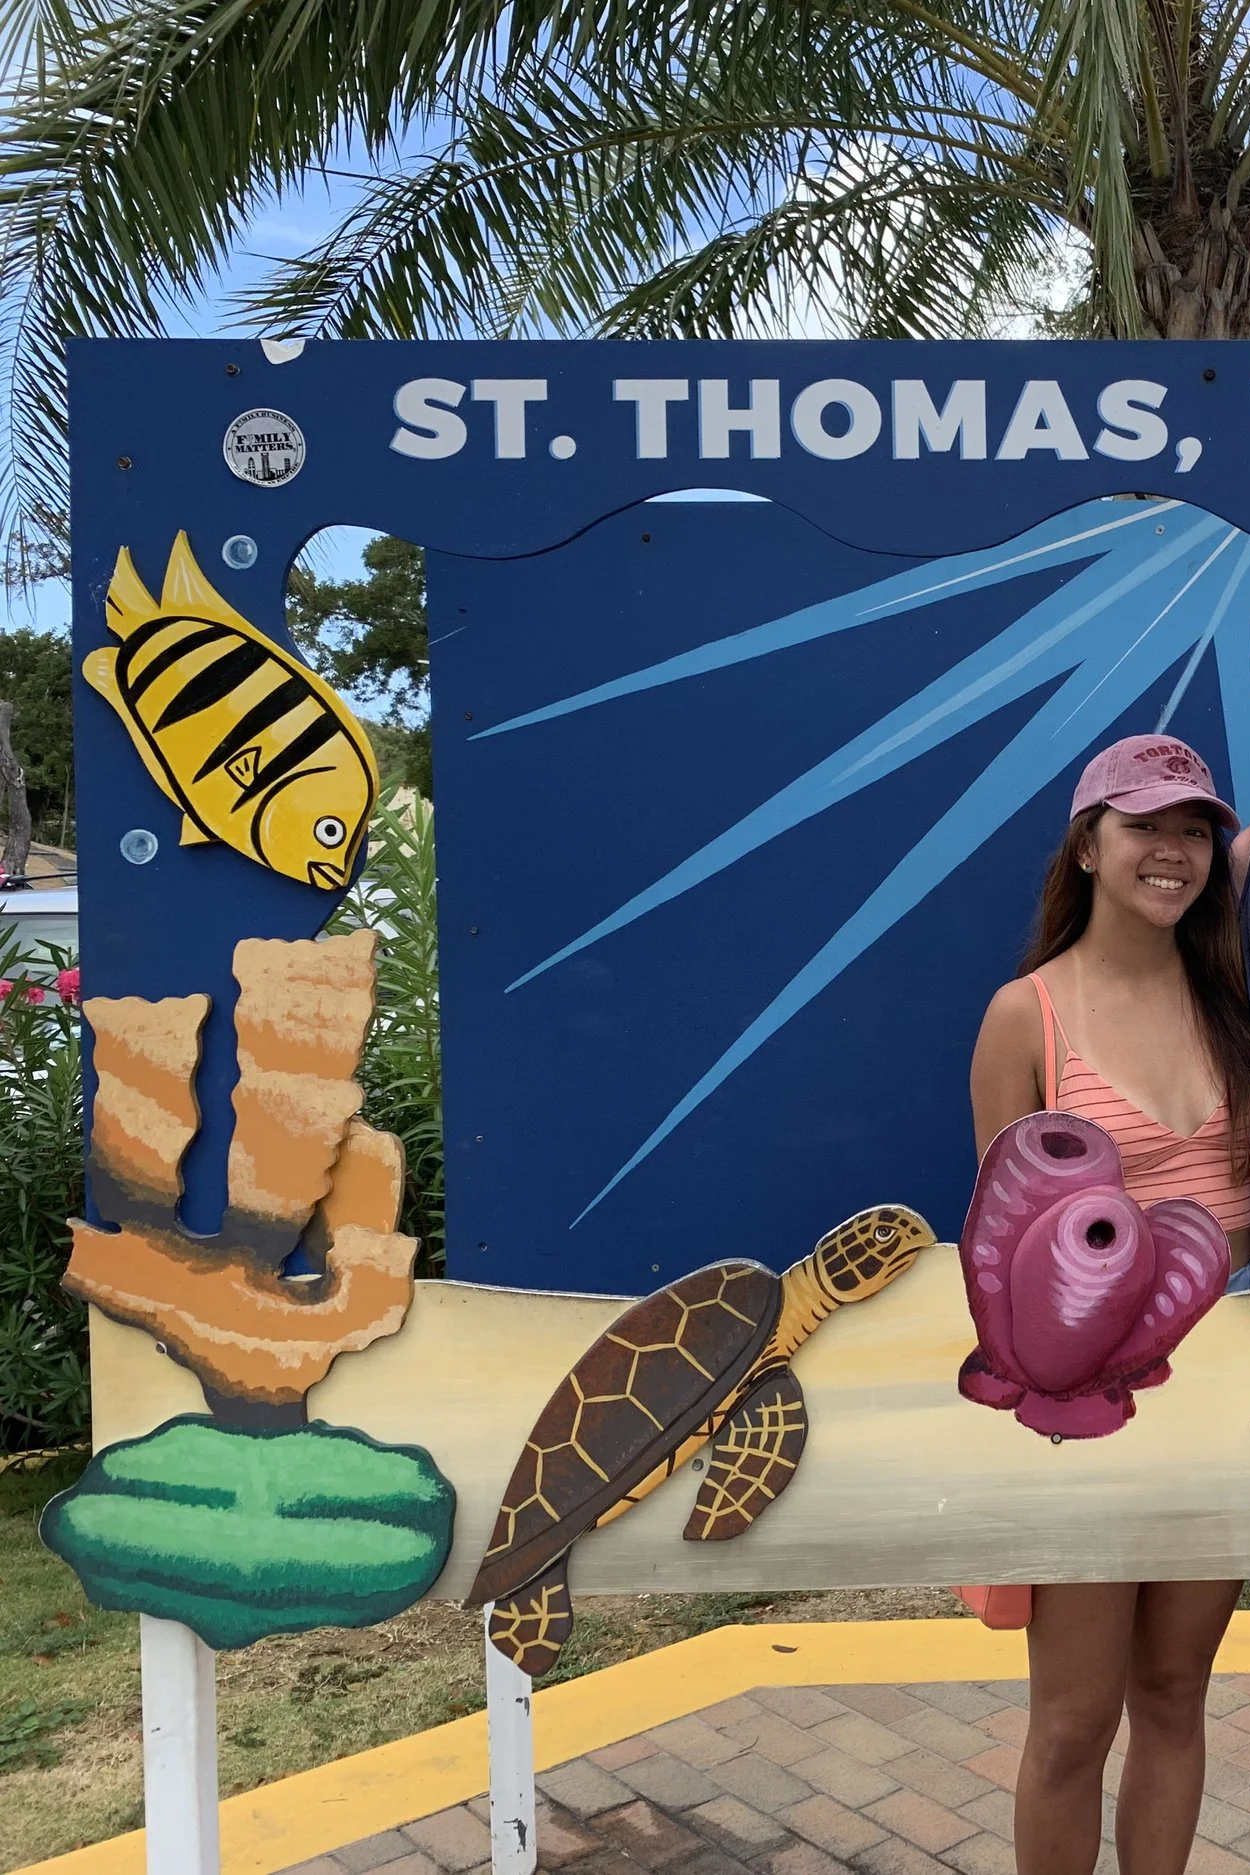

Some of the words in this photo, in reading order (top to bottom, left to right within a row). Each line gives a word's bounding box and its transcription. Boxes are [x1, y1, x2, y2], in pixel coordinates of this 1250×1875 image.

[389, 377, 577, 460] ST.
[612, 377, 1203, 474] THOMAS,
[1133, 744, 1207, 778] TORTOLA
